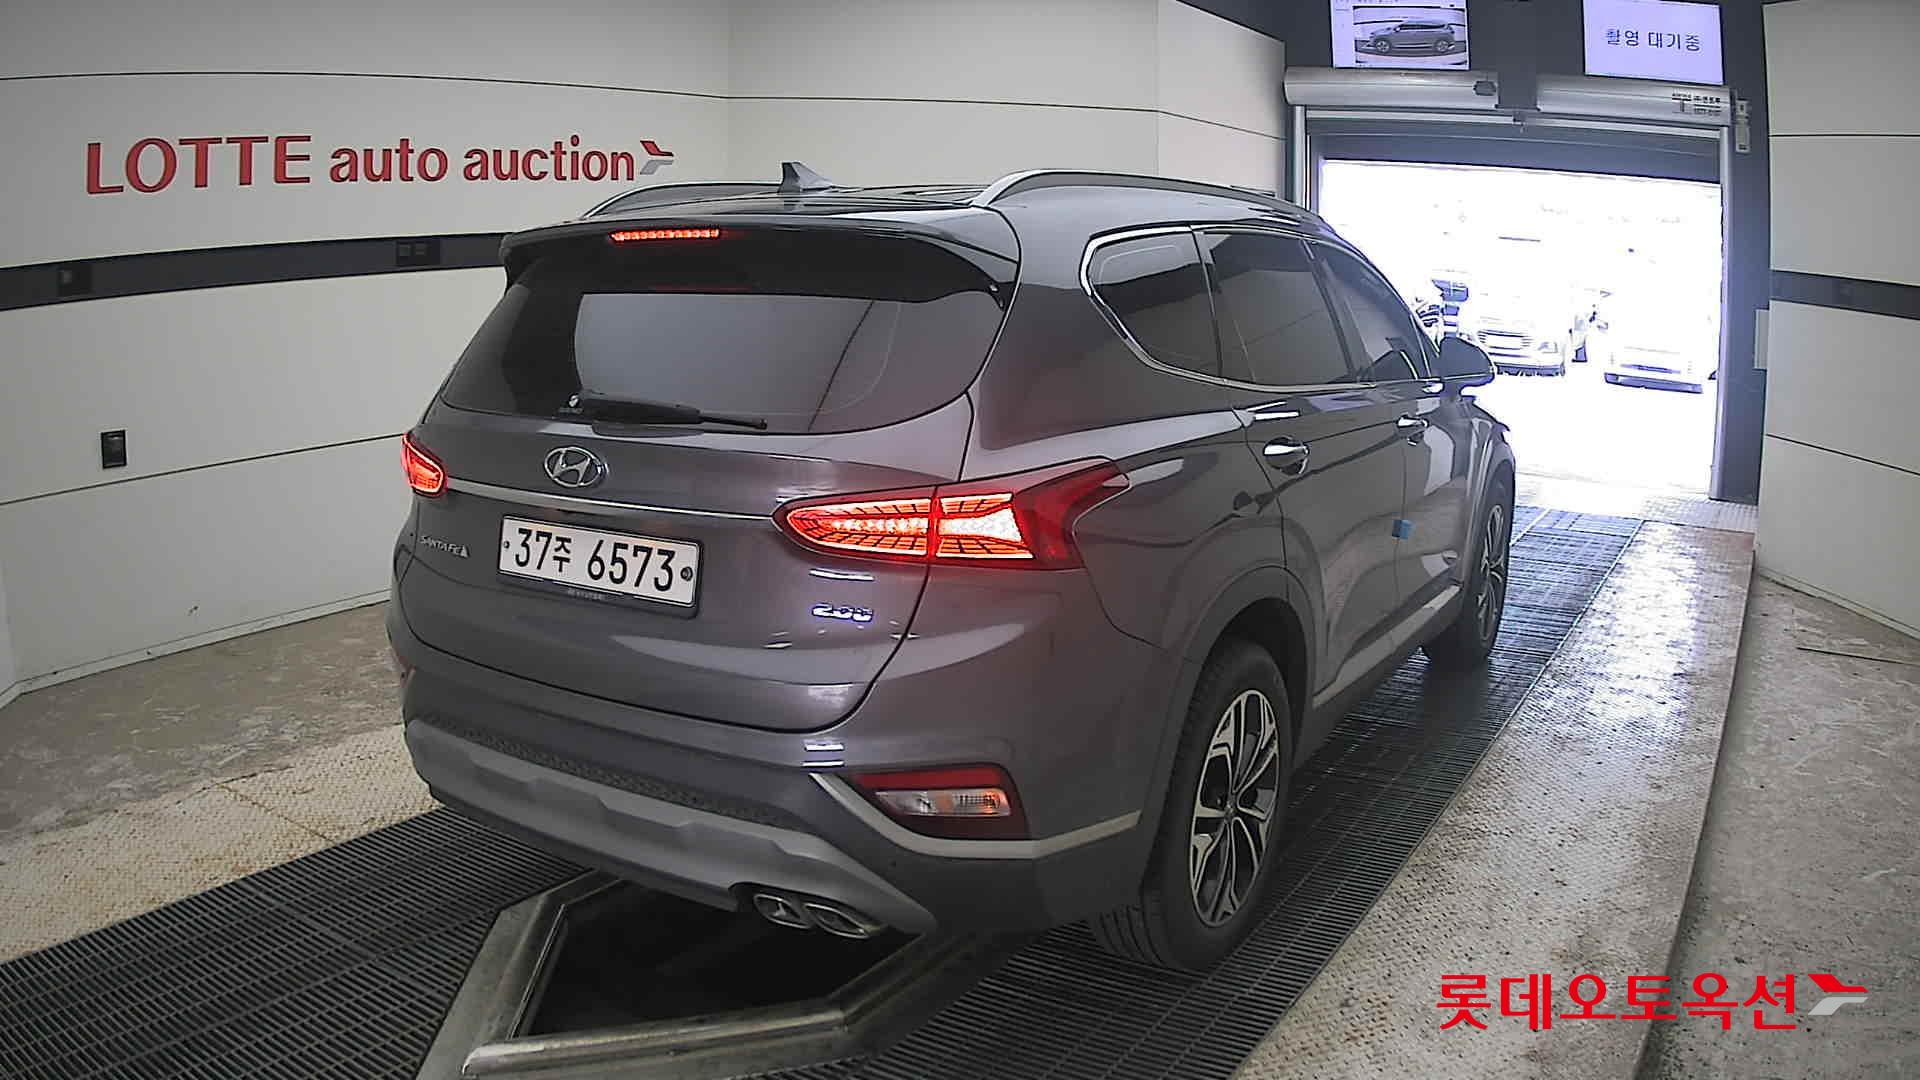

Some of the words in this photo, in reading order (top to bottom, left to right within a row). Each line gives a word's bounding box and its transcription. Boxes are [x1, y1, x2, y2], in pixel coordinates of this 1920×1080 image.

[1647, 31, 1700, 51] 대기중
[87, 135, 312, 194] LOTTE
[329, 138, 448, 182] auto
[463, 135, 635, 181] auction
[515, 527, 572, 573] 37주
[587, 539, 676, 592] 6573
